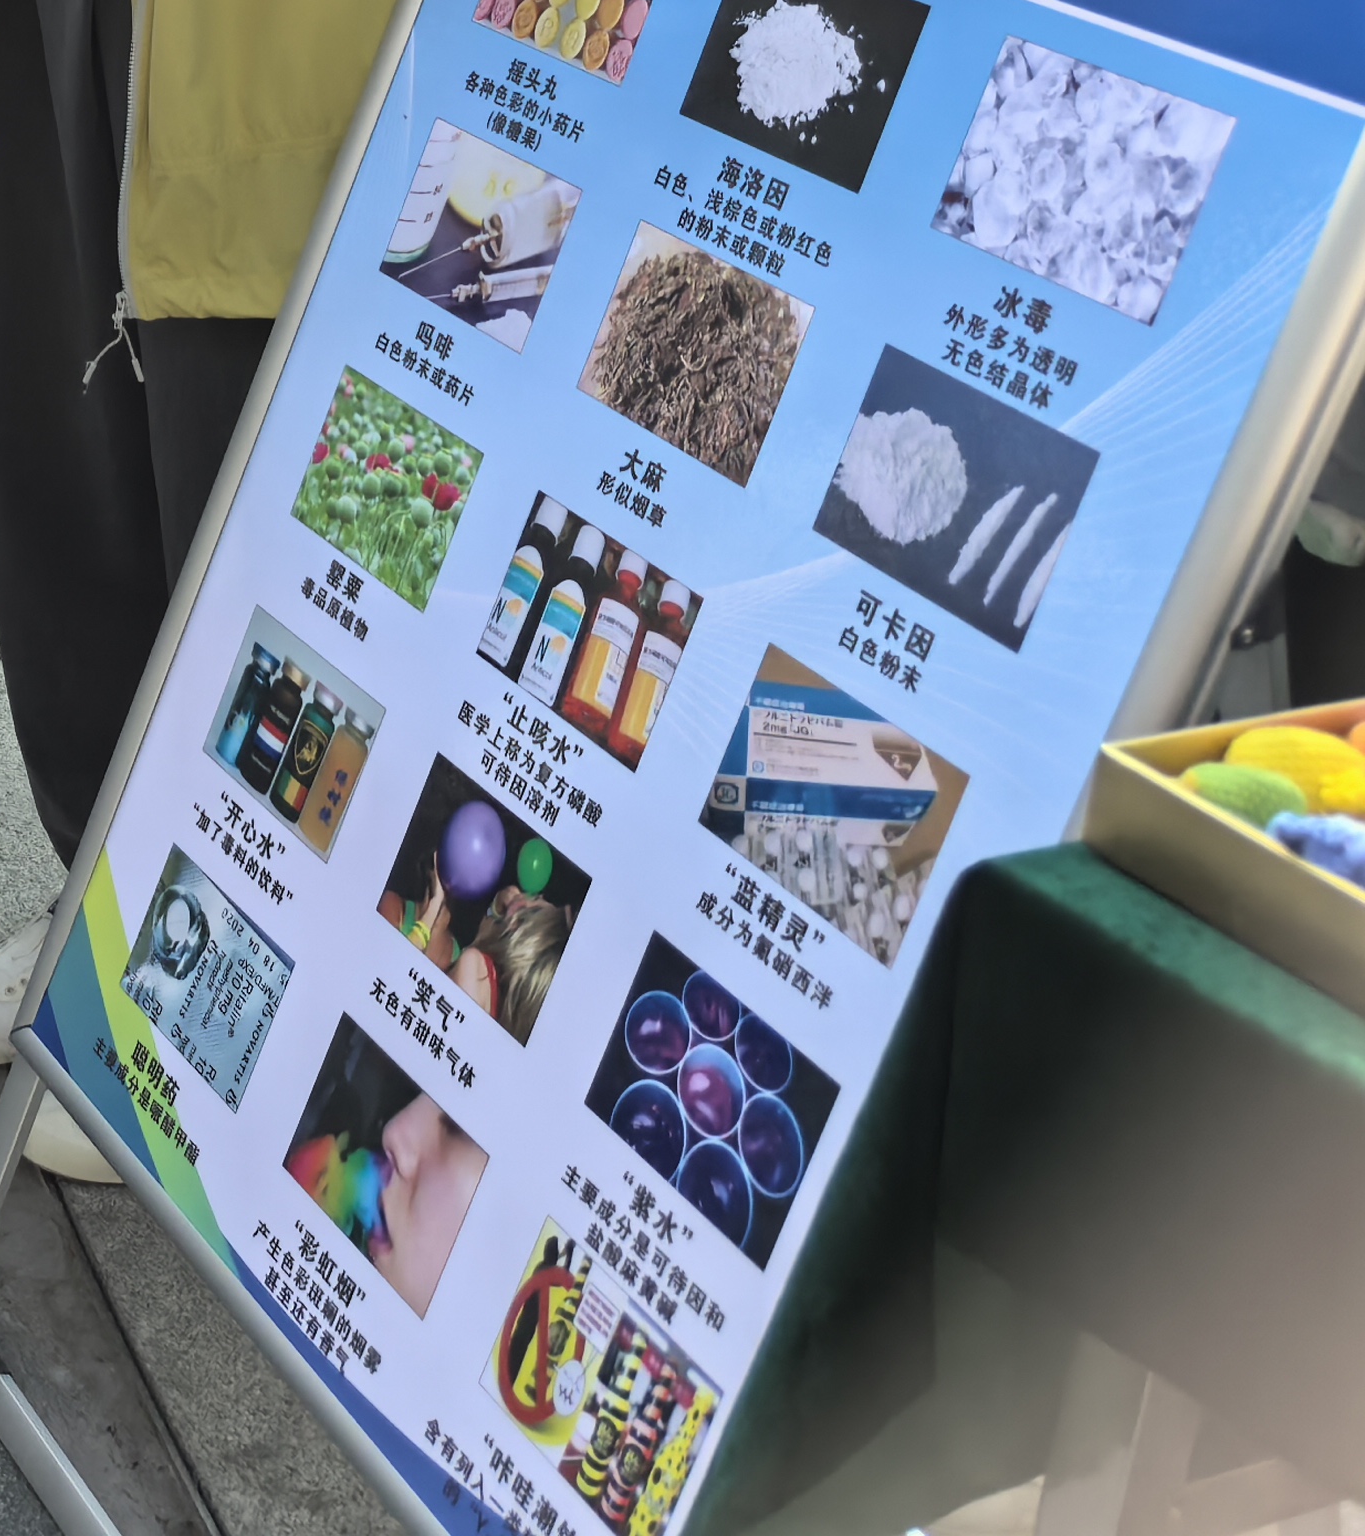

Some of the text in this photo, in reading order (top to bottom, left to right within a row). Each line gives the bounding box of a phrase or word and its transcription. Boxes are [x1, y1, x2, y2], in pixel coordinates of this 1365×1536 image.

[465, 71, 586, 144] 各种色彩的小药片
[506, 58, 558, 101] 摇头丸
[654, 164, 833, 268] 白色、浅棕色或粉红色
[716, 155, 791, 211] 海洛因
[677, 206, 786, 278] 的粉末或颗粒
[415, 321, 455, 362] 吗啡
[943, 303, 1079, 387] 外形多为透明
[993, 285, 1053, 334] 冰毒
[374, 332, 475, 407] 白色粉末或药片
[941, 338, 1053, 410] 无色结晶体
[596, 471, 667, 528] 形似烟草
[619, 448, 667, 493] 大麻
[300, 576, 369, 642] 毒品原植物
[325, 559, 365, 605] 罂粟
[838, 626, 922, 694] 白色粉末
[856, 589, 936, 663] 可卡因
[457, 700, 603, 828] 医学上称为复方磷酸
[481, 748, 561, 827] 可待因溶剂
[369, 976, 476, 1089] 无色有甜味气体
[130, 1039, 181, 1107] 聪明药
[560, 1164, 725, 1333] 主要成分是可待因和
[584, 1222, 679, 1326] 盐酸麻黄碱
[252, 1219, 382, 1375] 产生色彩斑斓的烟雾
[264, 1266, 350, 1376] 甚至还有香气
